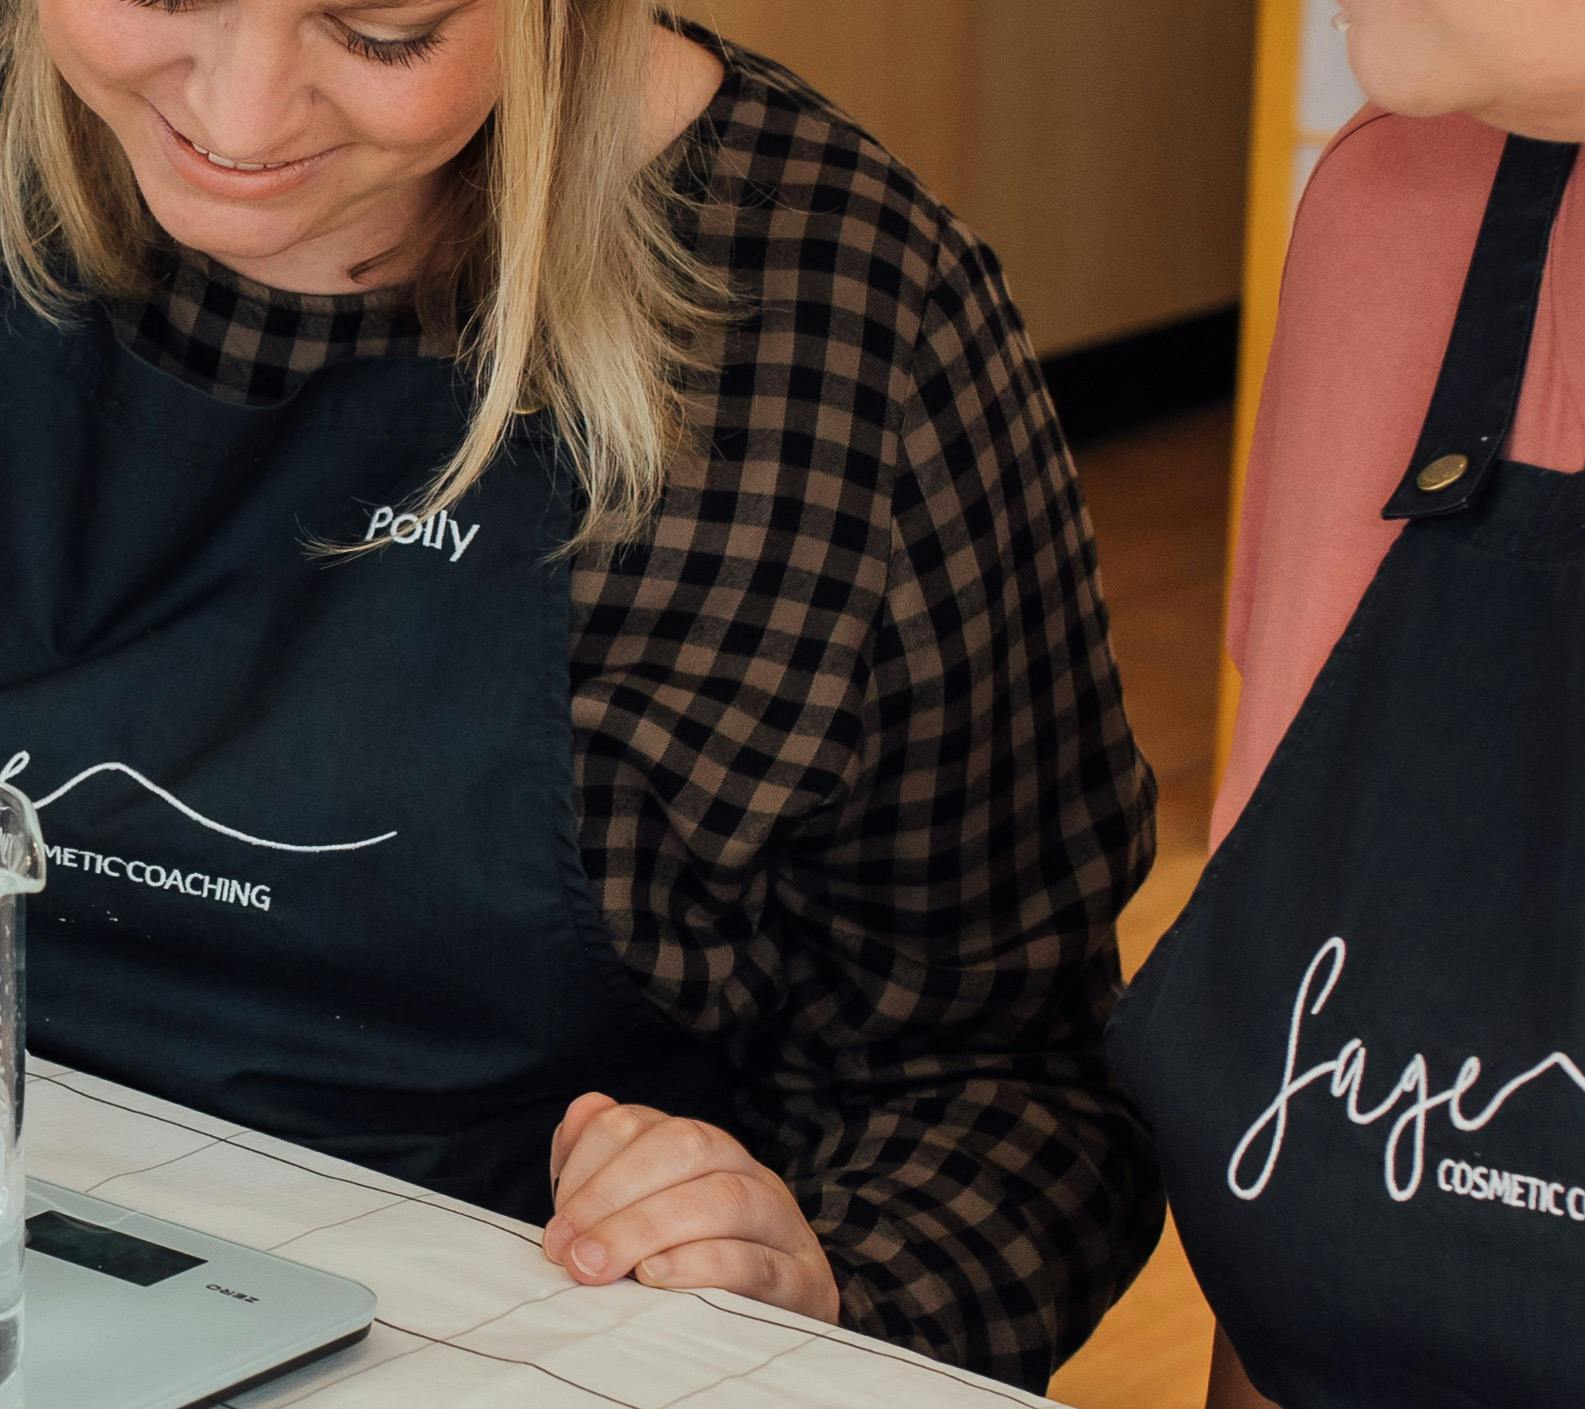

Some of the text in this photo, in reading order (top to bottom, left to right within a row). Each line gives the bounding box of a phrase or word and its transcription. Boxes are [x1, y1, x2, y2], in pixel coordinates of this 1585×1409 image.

[364, 506, 480, 562] Polly
[126, 860, 271, 911] COACHING
[1437, 1158, 1565, 1216] COSMETIC
[205, 1284, 260, 1304] ZERO
